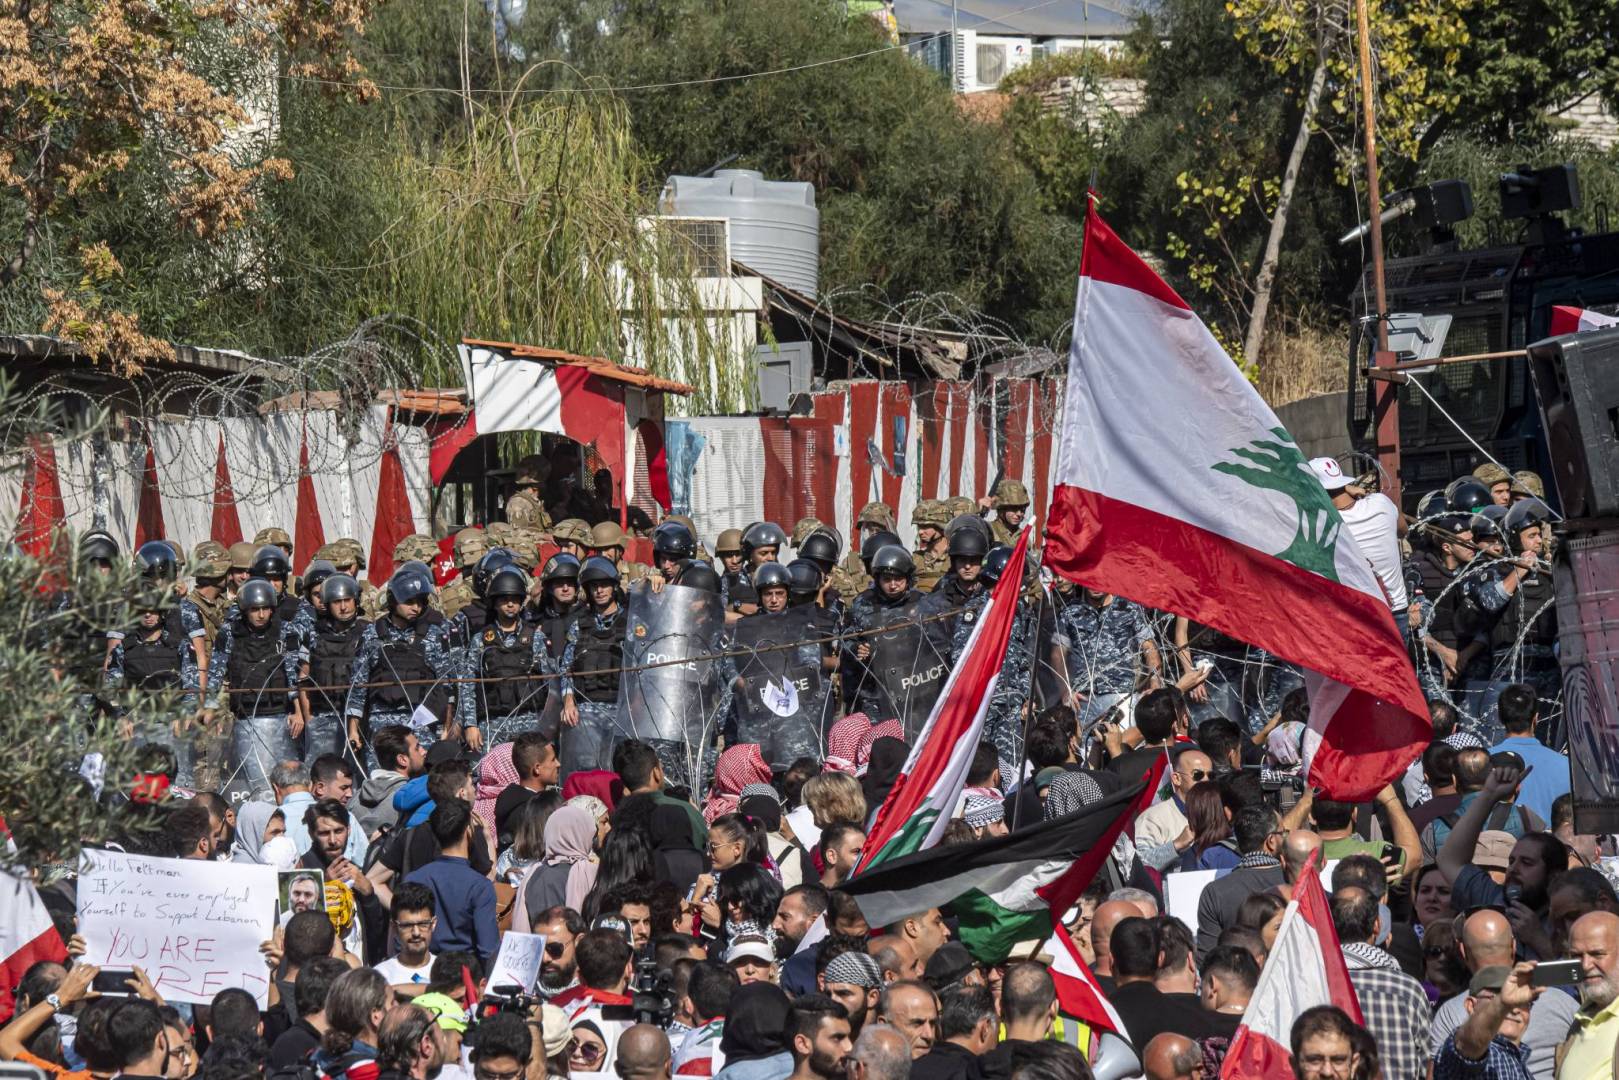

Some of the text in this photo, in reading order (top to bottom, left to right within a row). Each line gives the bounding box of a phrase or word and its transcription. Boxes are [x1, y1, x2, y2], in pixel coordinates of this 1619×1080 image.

[134, 903, 147, 918] to
[106, 927, 216, 964] YOU ARE
